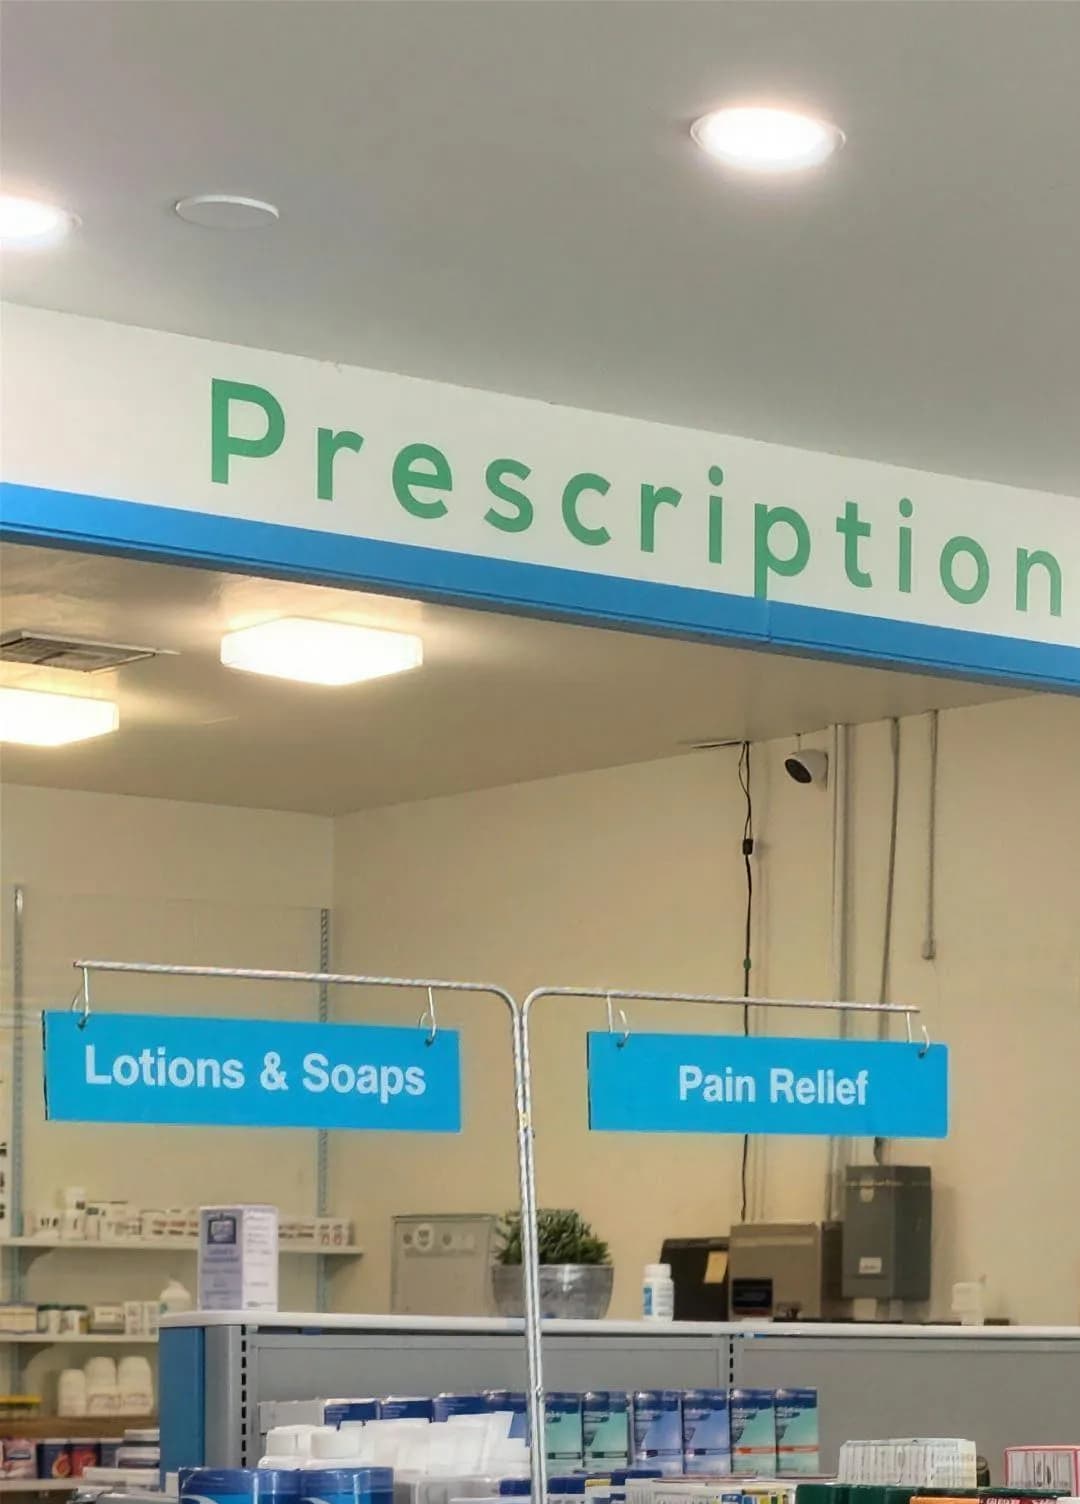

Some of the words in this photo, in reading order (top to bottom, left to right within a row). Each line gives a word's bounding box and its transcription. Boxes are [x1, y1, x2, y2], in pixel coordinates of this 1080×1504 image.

[87, 1045, 244, 1092] Lotions
[260, 1052, 288, 1091] &
[302, 1052, 427, 1101] Soaps
[679, 1066, 755, 1103] Pain
[770, 1068, 869, 1105] Relief
